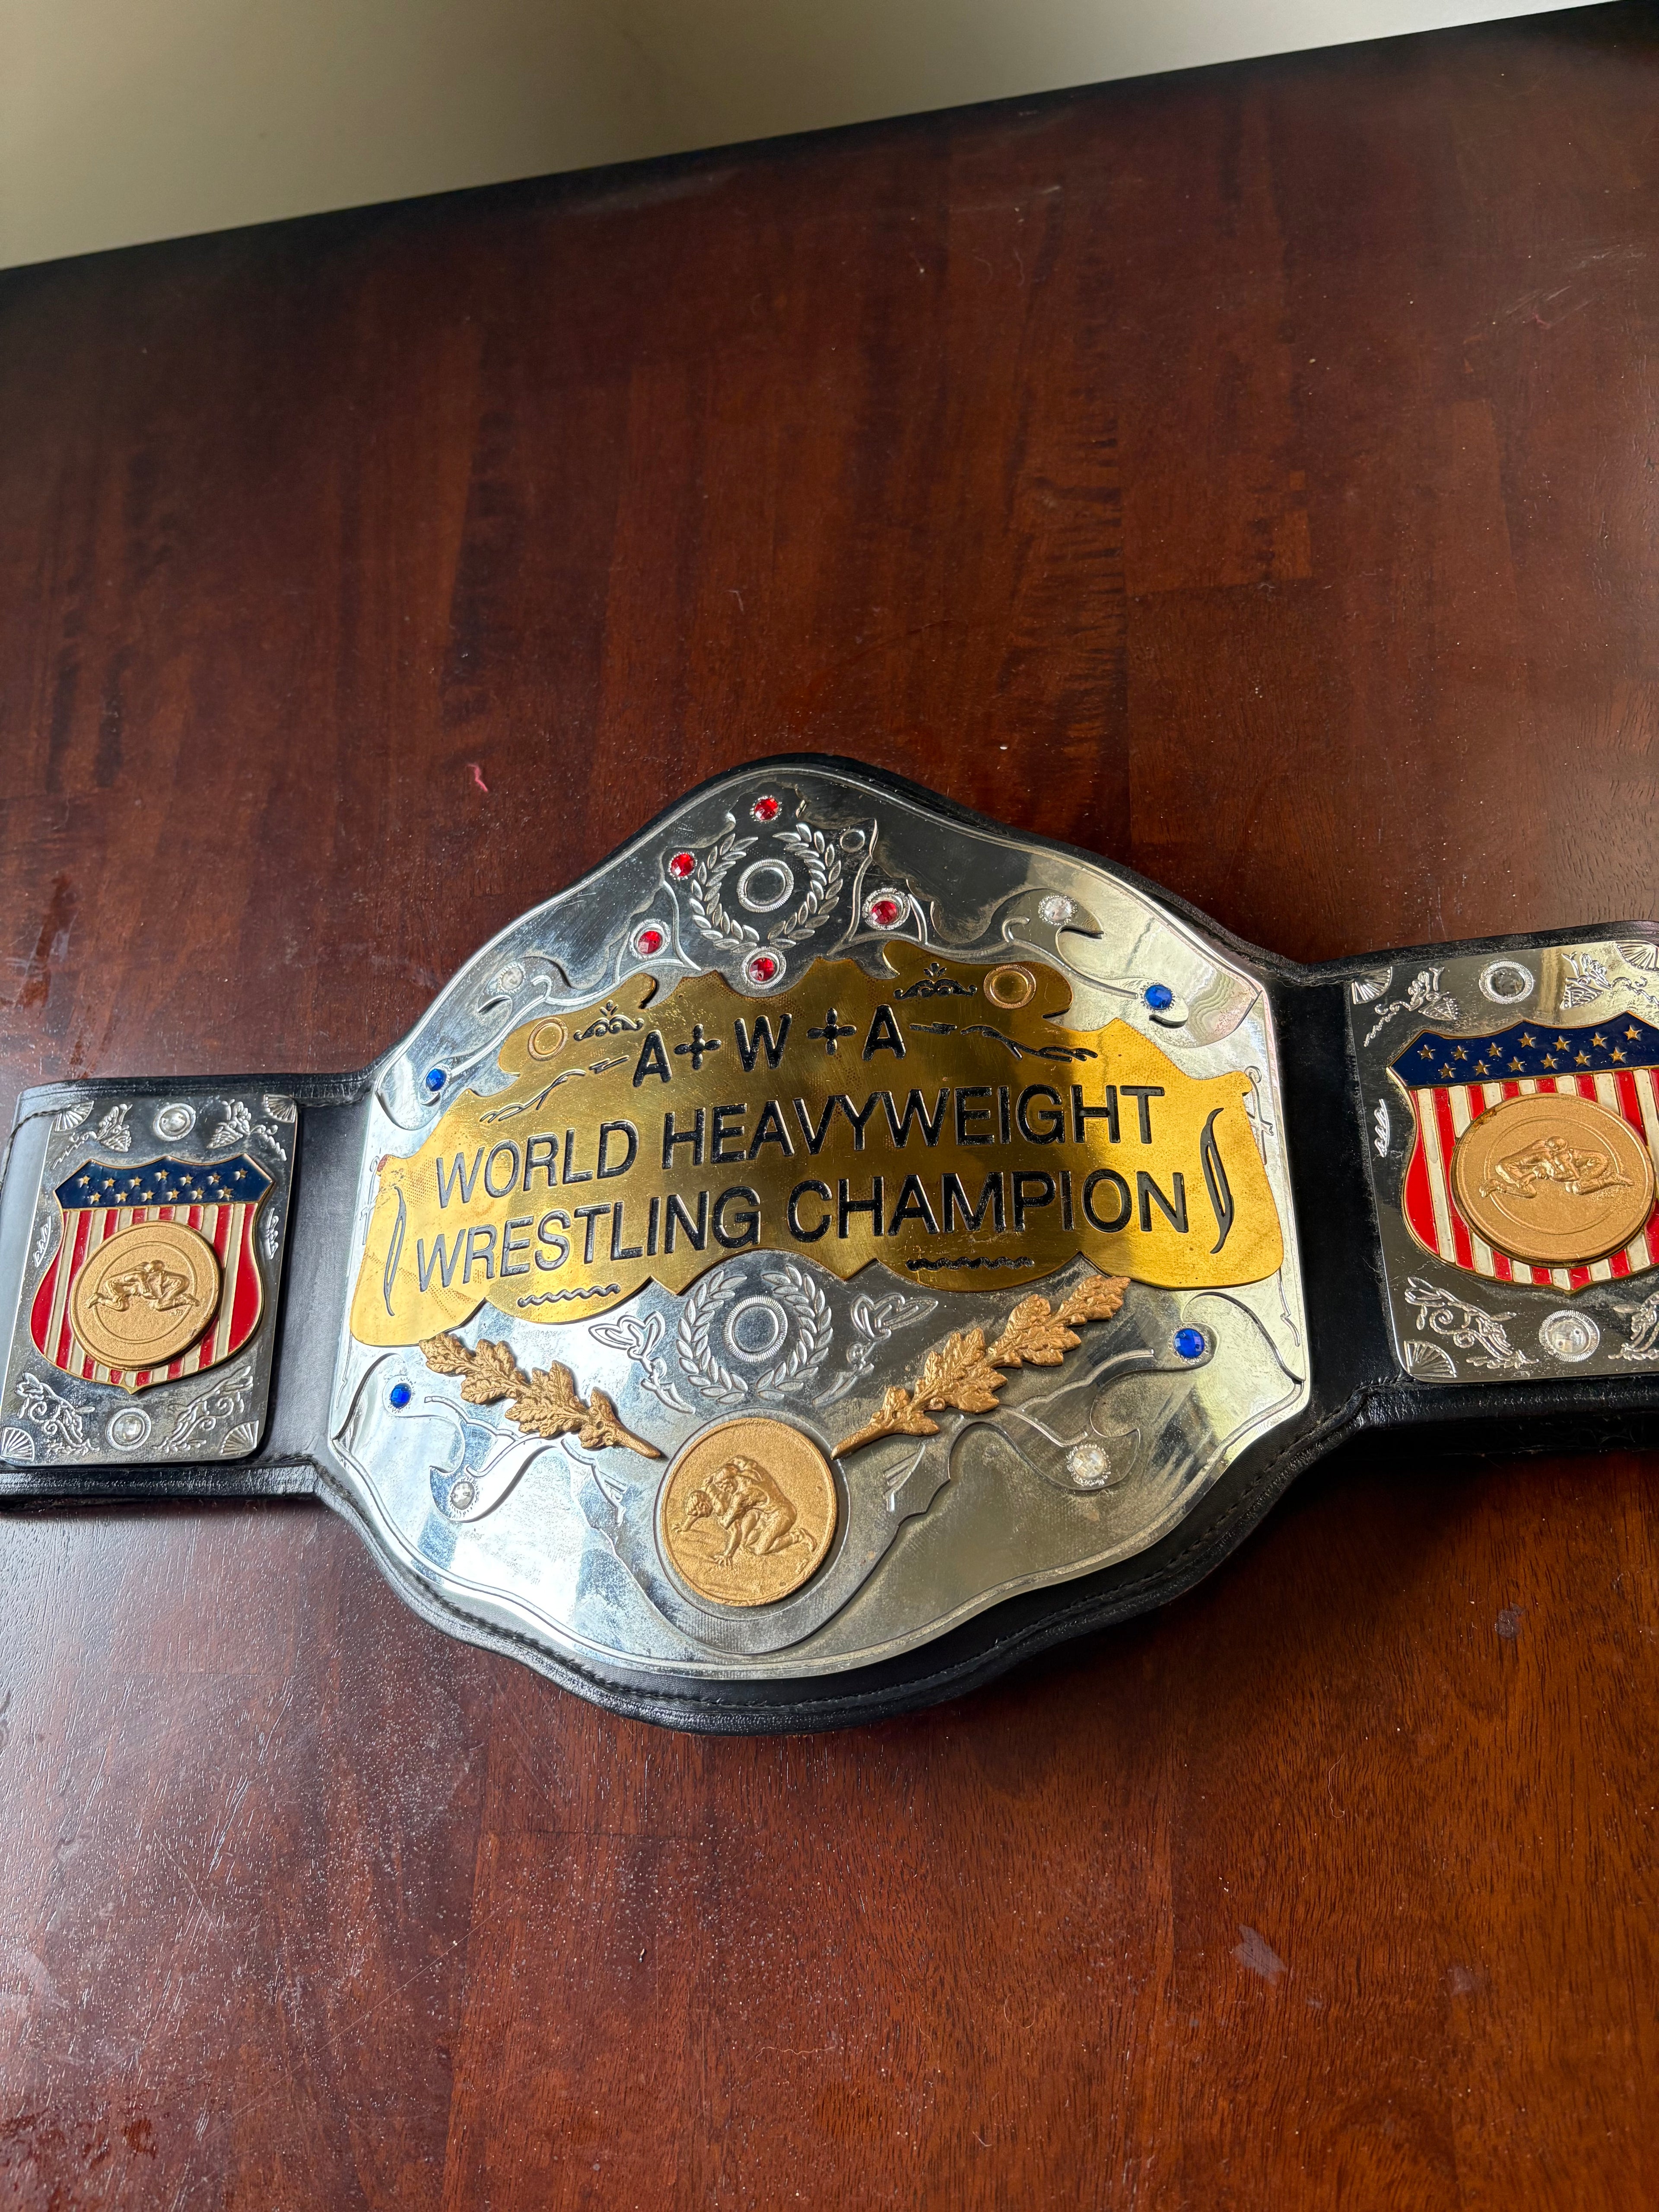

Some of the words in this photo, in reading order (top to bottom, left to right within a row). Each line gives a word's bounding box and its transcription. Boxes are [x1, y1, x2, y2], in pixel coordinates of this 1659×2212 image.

[436, 1119, 639, 1208] WORLD
[661, 1084, 1165, 1170] HEAVYWEIGHT
[416, 1185, 762, 1292] WRESTLING
[786, 1169, 1189, 1243] CHAMPION
